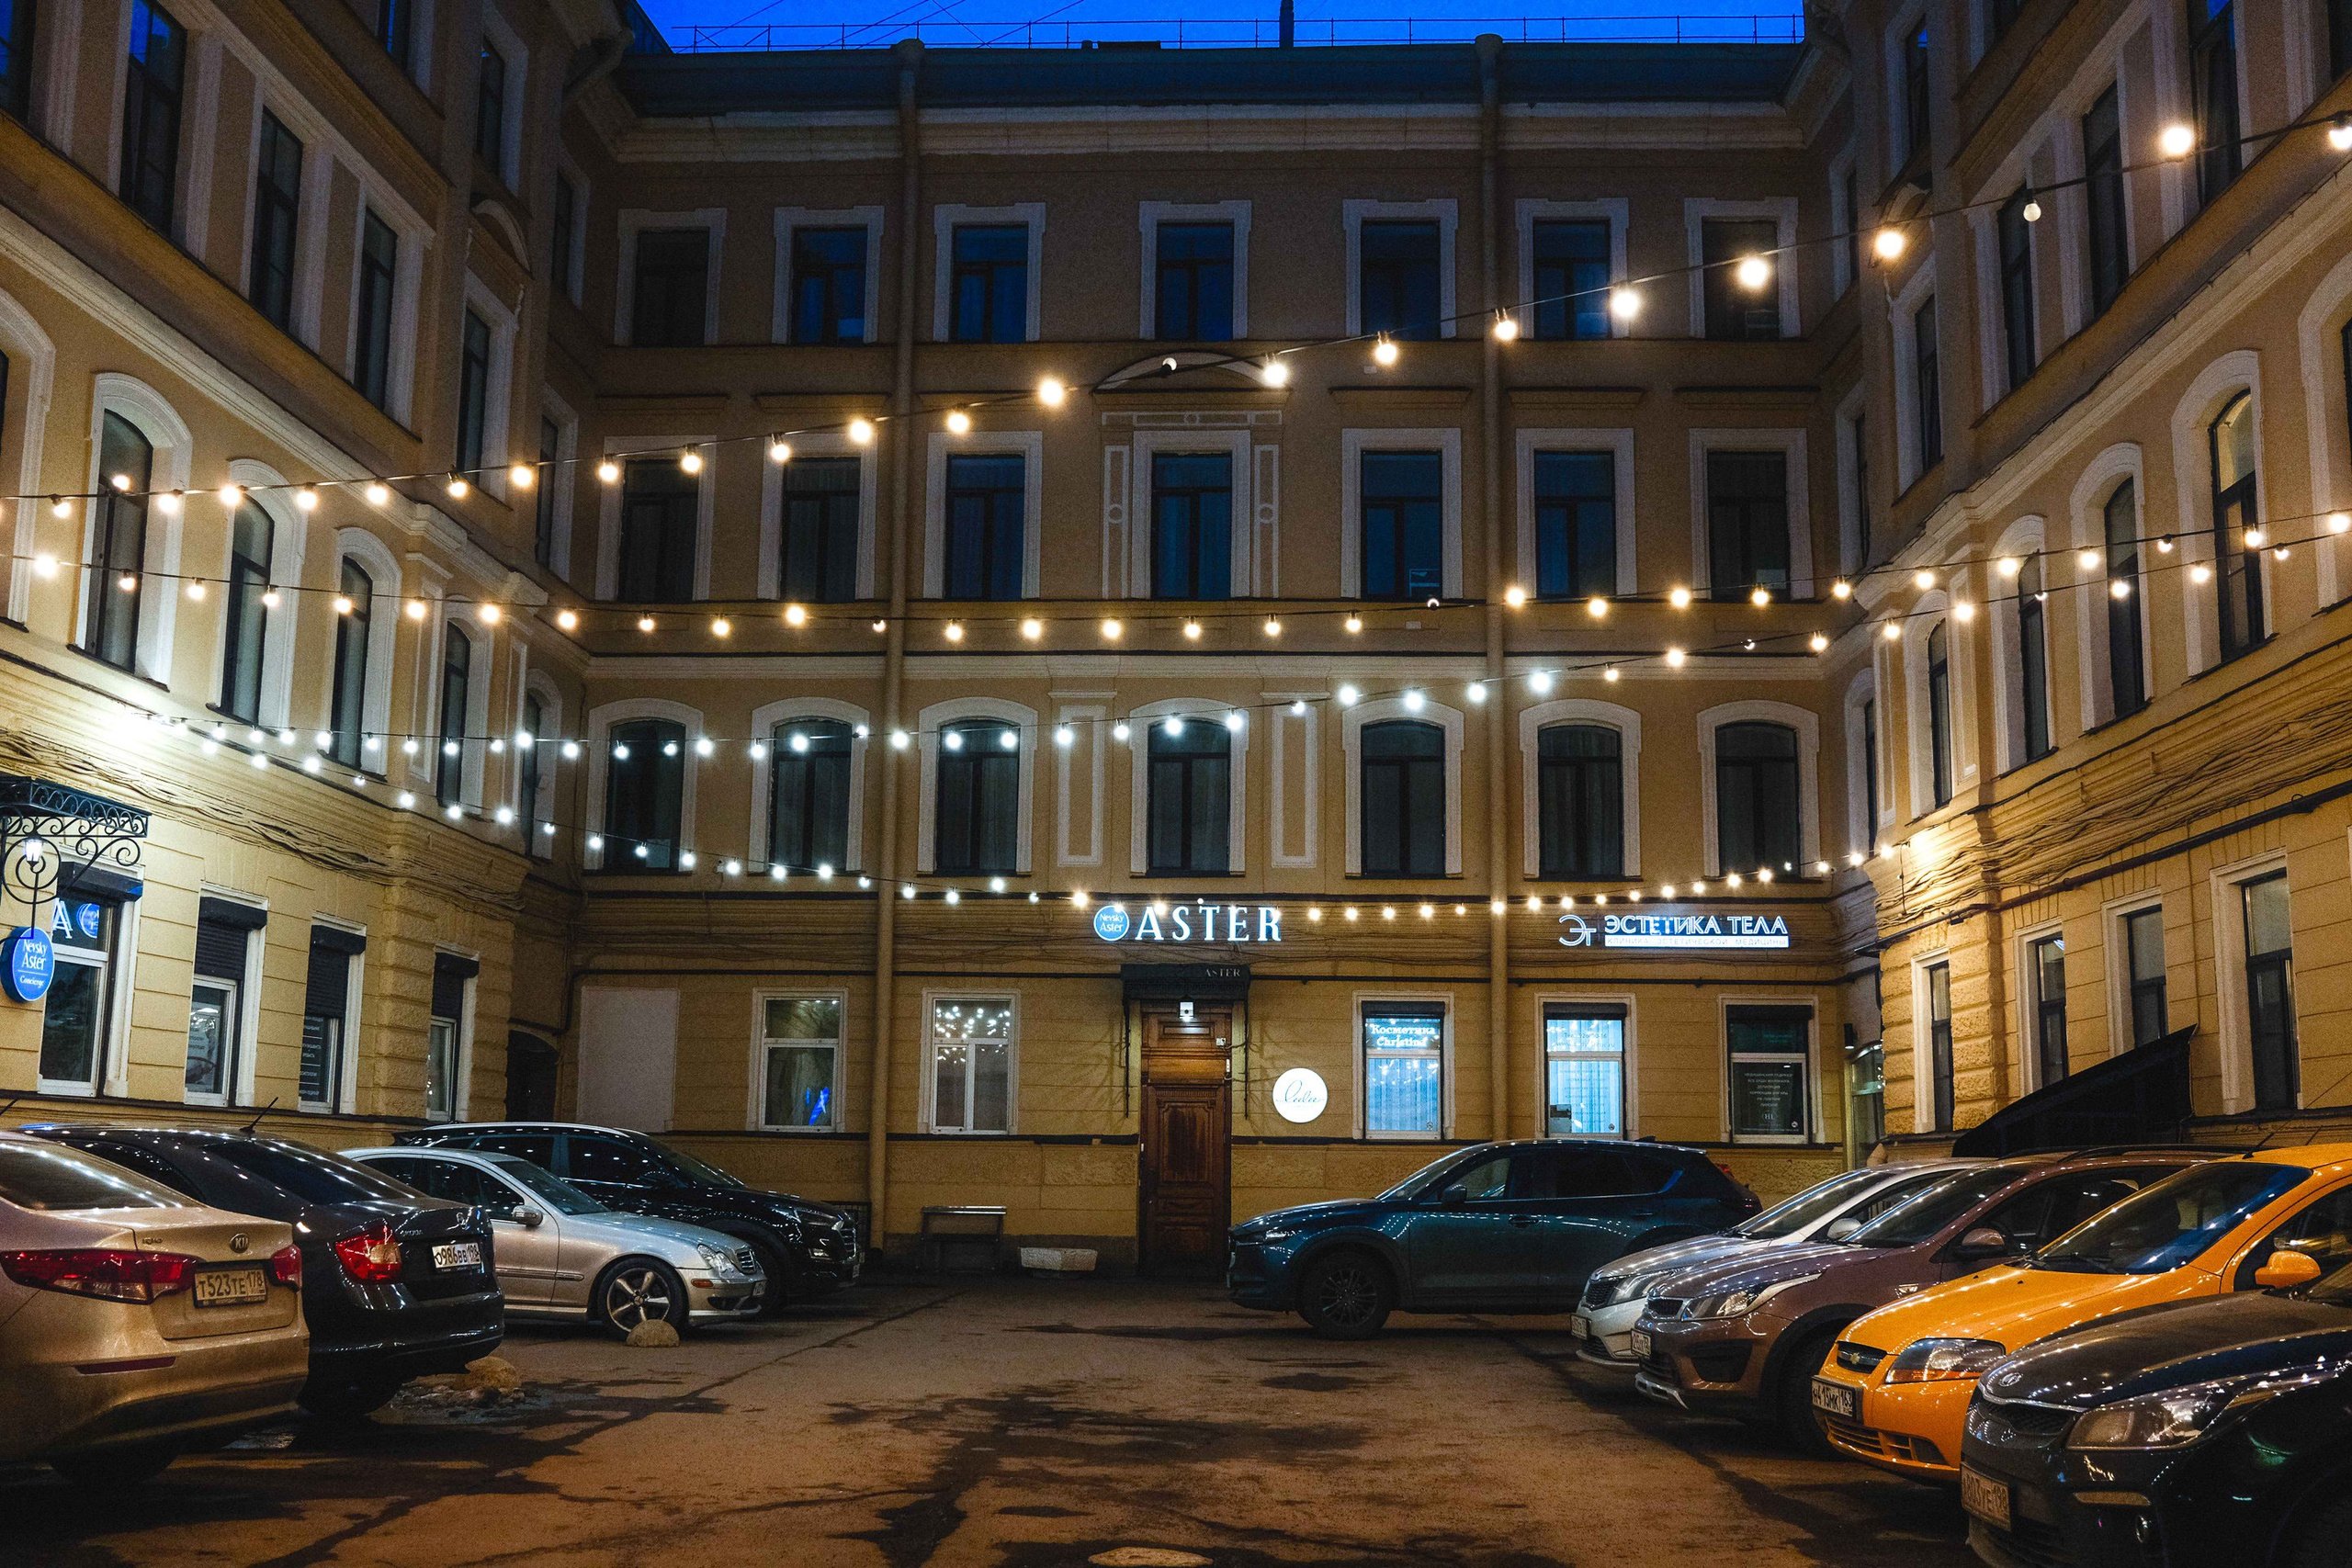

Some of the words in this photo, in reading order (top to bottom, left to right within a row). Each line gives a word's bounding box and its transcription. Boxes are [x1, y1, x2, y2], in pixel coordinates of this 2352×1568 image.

[1099, 913, 1125, 923] Nevsky
[1135, 906, 1282, 942] ASTER
[1100, 922, 1124, 933] Aster
[1604, 915, 1721, 935] ЭСТЕТИКА
[1727, 916, 1788, 934] ТЕЛА
[22, 939, 48, 957] Nevsky
[1607, 937, 1649, 945] КЛИНИКА
[1736, 937, 1787, 946] МЕДИЦИНЫ
[21, 952, 47, 970] Aster
[1204, 968, 1240, 977] ASTER
[19, 975, 45, 988] Concierge
